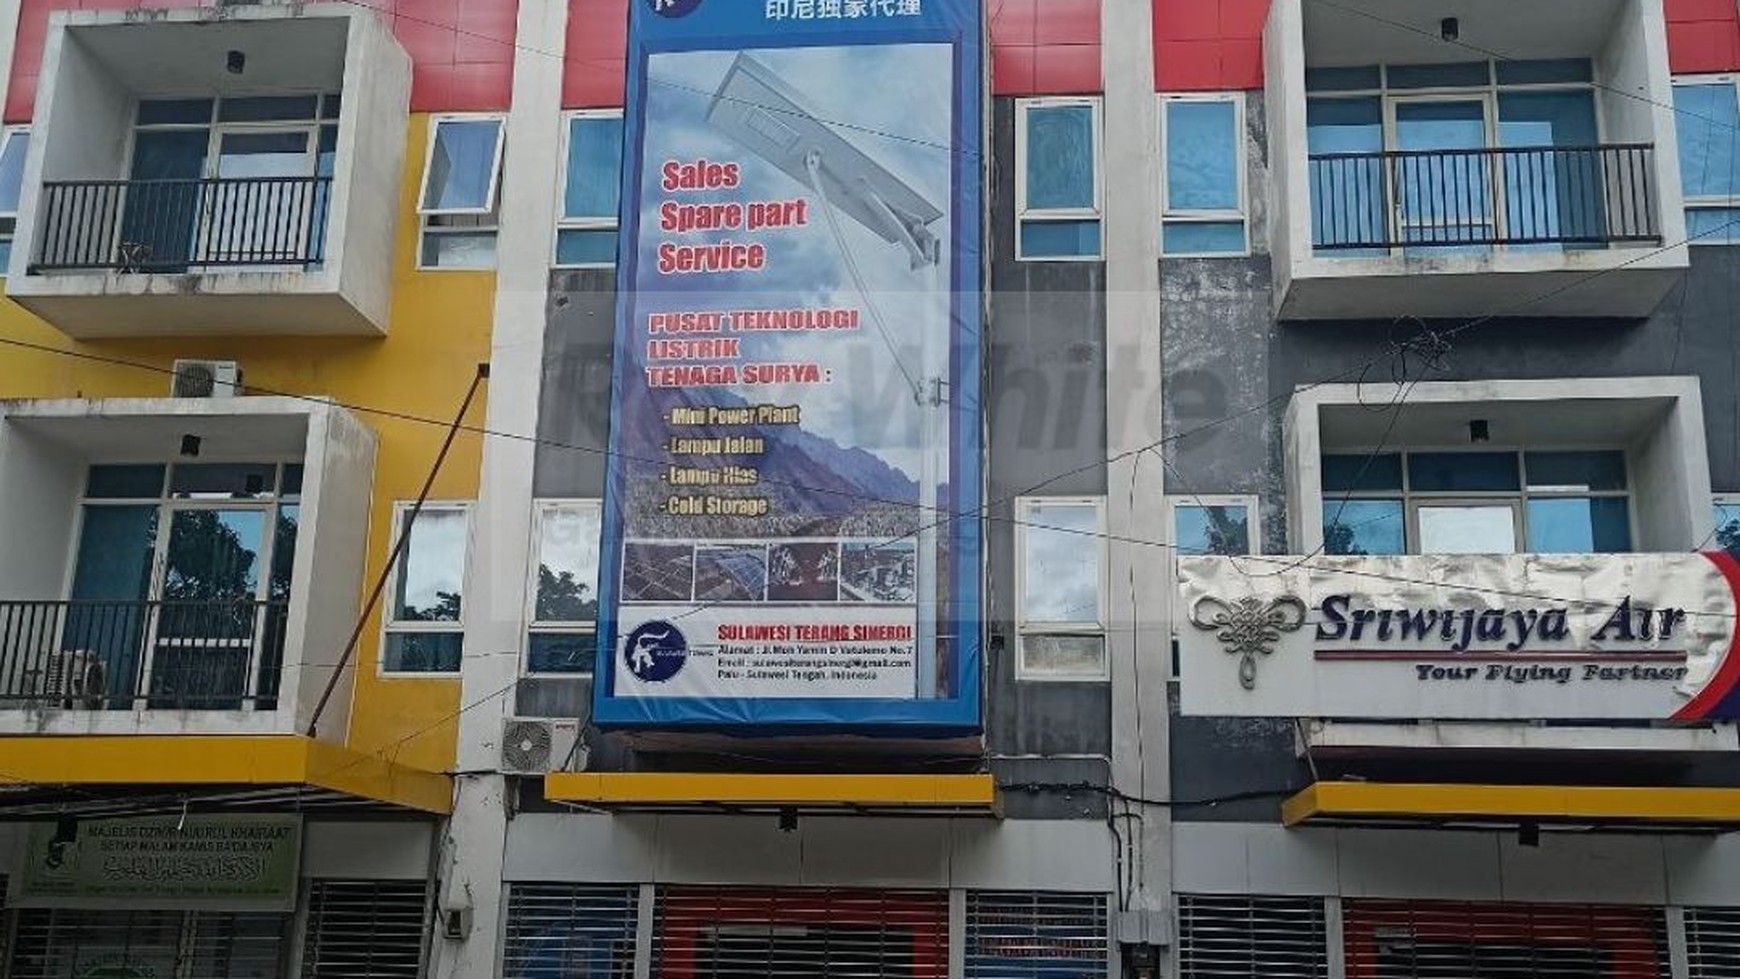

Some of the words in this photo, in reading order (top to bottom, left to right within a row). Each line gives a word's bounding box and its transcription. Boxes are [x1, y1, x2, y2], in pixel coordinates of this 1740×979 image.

[662, 160, 739, 190] Sales
[661, 201, 742, 232] Spare
[747, 199, 806, 230] part
[658, 242, 764, 273] Service
[648, 311, 725, 333] PUSAT
[729, 309, 859, 330] TEKNOLOGI
[647, 338, 740, 358] LISTRIK
[646, 364, 737, 386] TENAGA
[742, 364, 820, 384] SURYA
[672, 408, 705, 425] Mini
[708, 407, 756, 424] Power
[758, 405, 799, 423] Plant
[671, 436, 720, 456] Lampu
[724, 436, 763, 453] Jalan
[669, 467, 720, 486] Lampu
[668, 496, 703, 515] Cold
[707, 495, 768, 516] Storage
[718, 624, 790, 640] SULAWESI
[794, 624, 850, 641] TERANG
[853, 624, 912, 640] SINERGI
[1315, 595, 1570, 651] Sriwijaya
[1593, 596, 1687, 641] Air
[1416, 664, 1478, 680] Your
[1486, 664, 1572, 684] Flying
